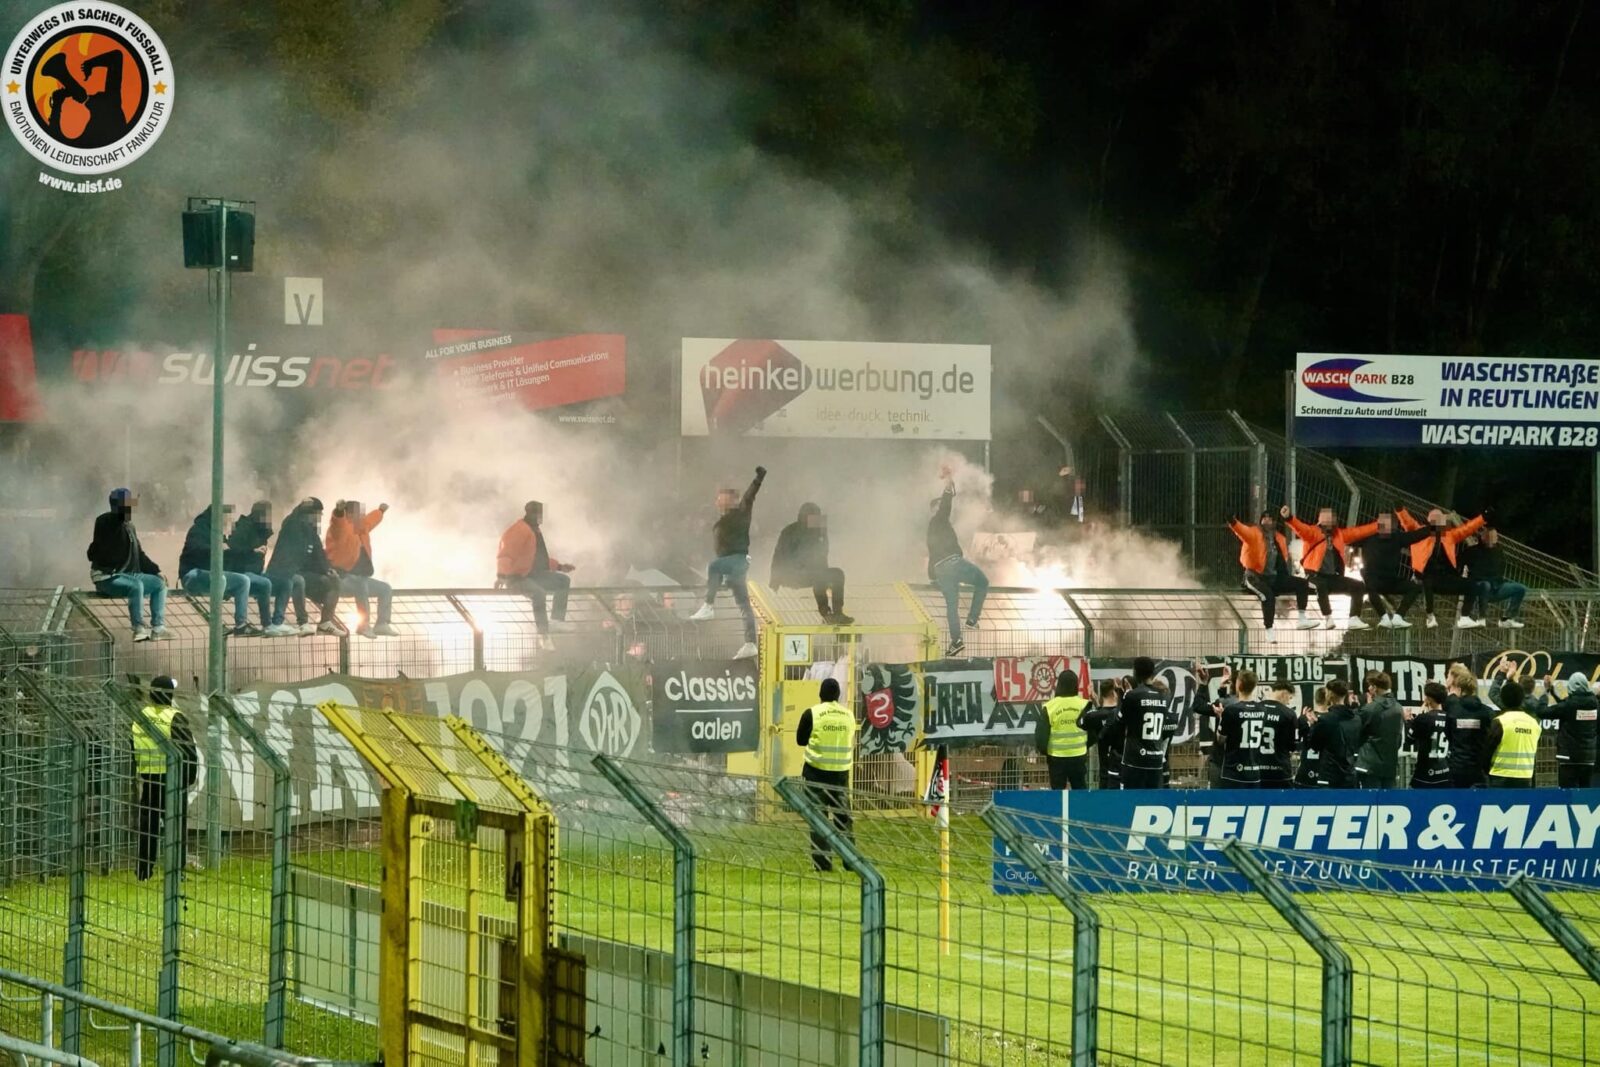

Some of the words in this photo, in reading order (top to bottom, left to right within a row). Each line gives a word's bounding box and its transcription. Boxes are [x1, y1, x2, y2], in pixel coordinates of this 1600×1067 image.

[293, 293, 315, 326] V
[425, 349, 439, 358] ALL
[440, 346, 454, 356] FOR
[455, 341, 476, 353] YOUR
[477, 335, 512, 349] BUSINESS
[158, 343, 395, 389] swissnet
[480, 369, 514, 382] Telefonie
[522, 362, 549, 375] Unified
[494, 357, 524, 369] Provider
[516, 374, 550, 387] Lösungen
[816, 361, 974, 400] werbung.de
[1303, 372, 1349, 384] WASCH
[1355, 374, 1387, 385] PARK
[1391, 374, 1415, 385] B28
[1440, 388, 1464, 407] IN
[1467, 388, 1600, 409] REUTLINGEN
[1301, 405, 1342, 415] Schonend
[1355, 407, 1375, 416] Auto
[1377, 407, 1393, 416] und
[1394, 407, 1427, 417] Umwelt
[1421, 424, 1555, 446] WASCHPARK
[1558, 426, 1599, 447] B28
[1285, 657, 1323, 681] 1916
[664, 669, 756, 702] classics
[691, 718, 741, 740] aalen
[1142, 712, 1164, 740] 20
[1240, 720, 1263, 748] 15
[1126, 805, 1412, 851] PFEIFFER
[1417, 804, 1466, 850] &
